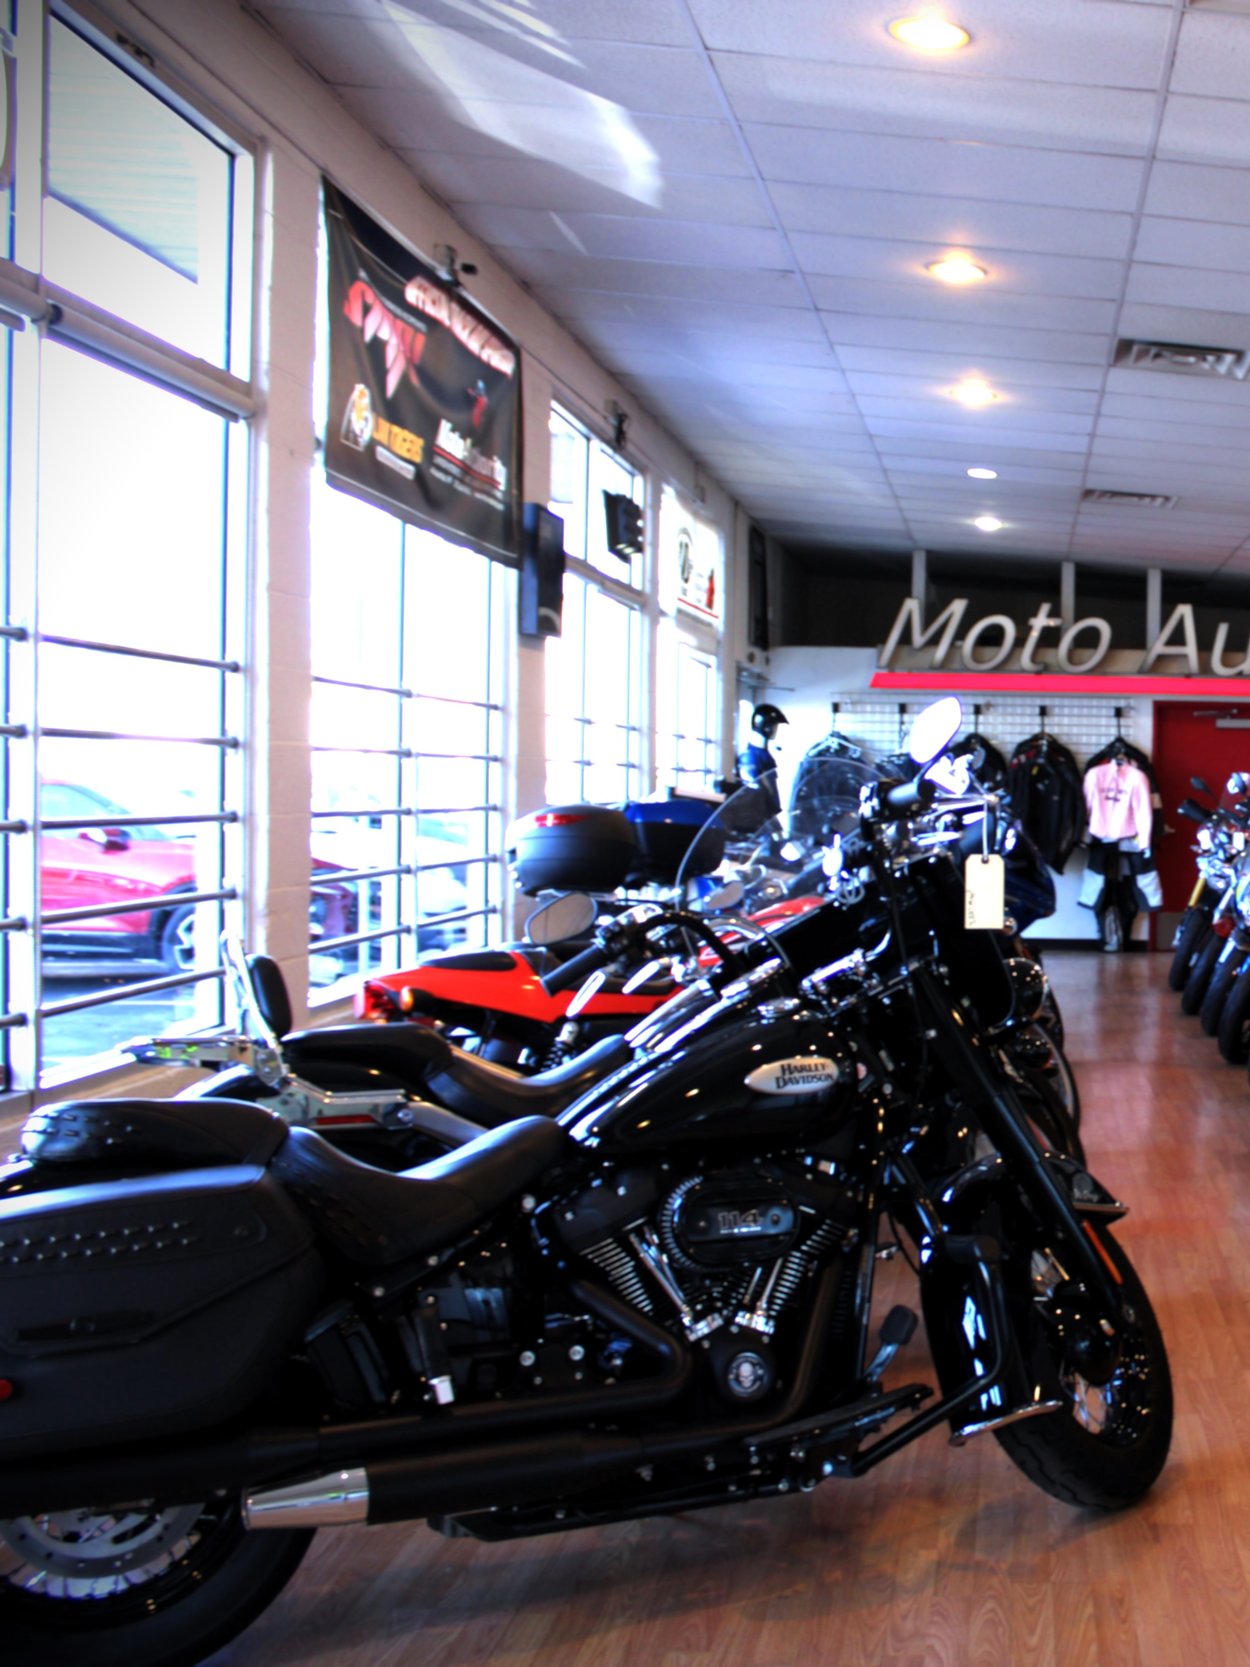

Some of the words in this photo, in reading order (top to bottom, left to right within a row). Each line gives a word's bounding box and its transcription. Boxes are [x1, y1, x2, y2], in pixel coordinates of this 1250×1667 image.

[876, 598, 1112, 673] Moto
[775, 1072, 835, 1089] DAVIDSON
[718, 1209, 764, 1229] 114
